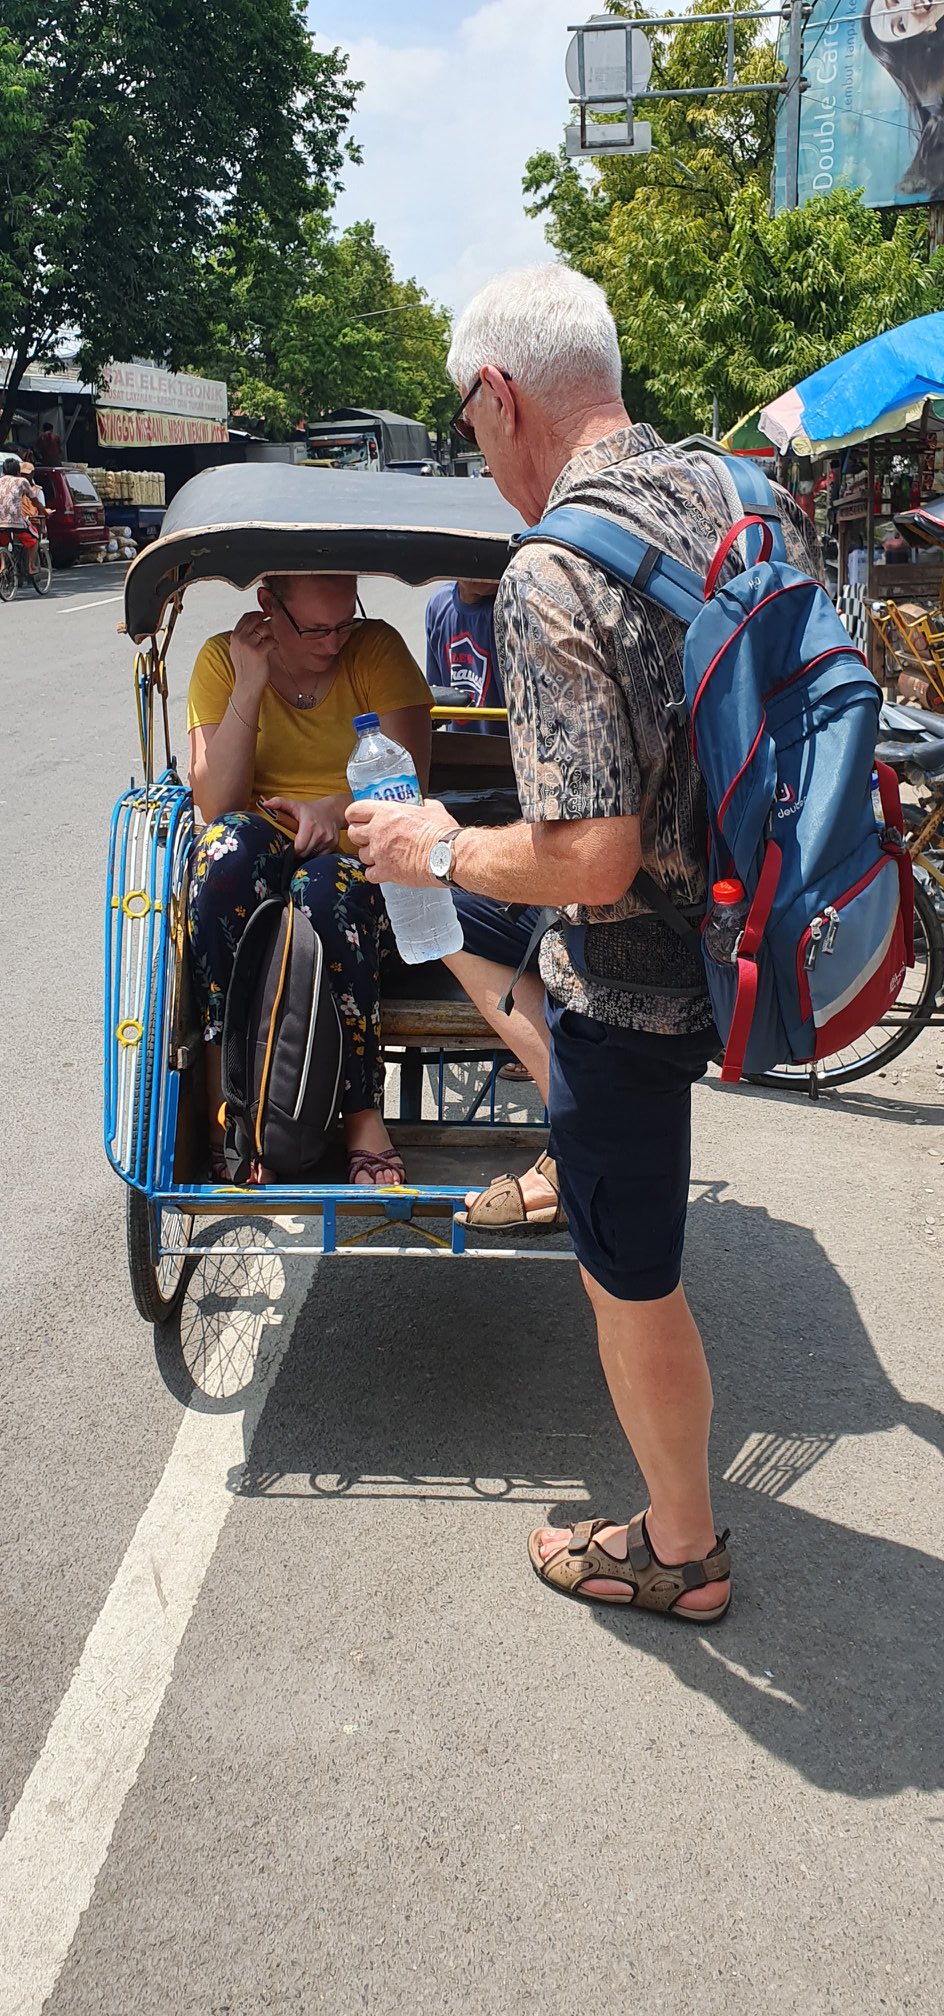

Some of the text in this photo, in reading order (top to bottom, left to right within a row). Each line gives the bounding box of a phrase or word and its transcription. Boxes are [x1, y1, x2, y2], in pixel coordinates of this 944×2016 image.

[813, 22, 839, 190] Double Care
[140, 373, 223, 402] ELEKTRONIK
[373, 784, 415, 802] AQUA
